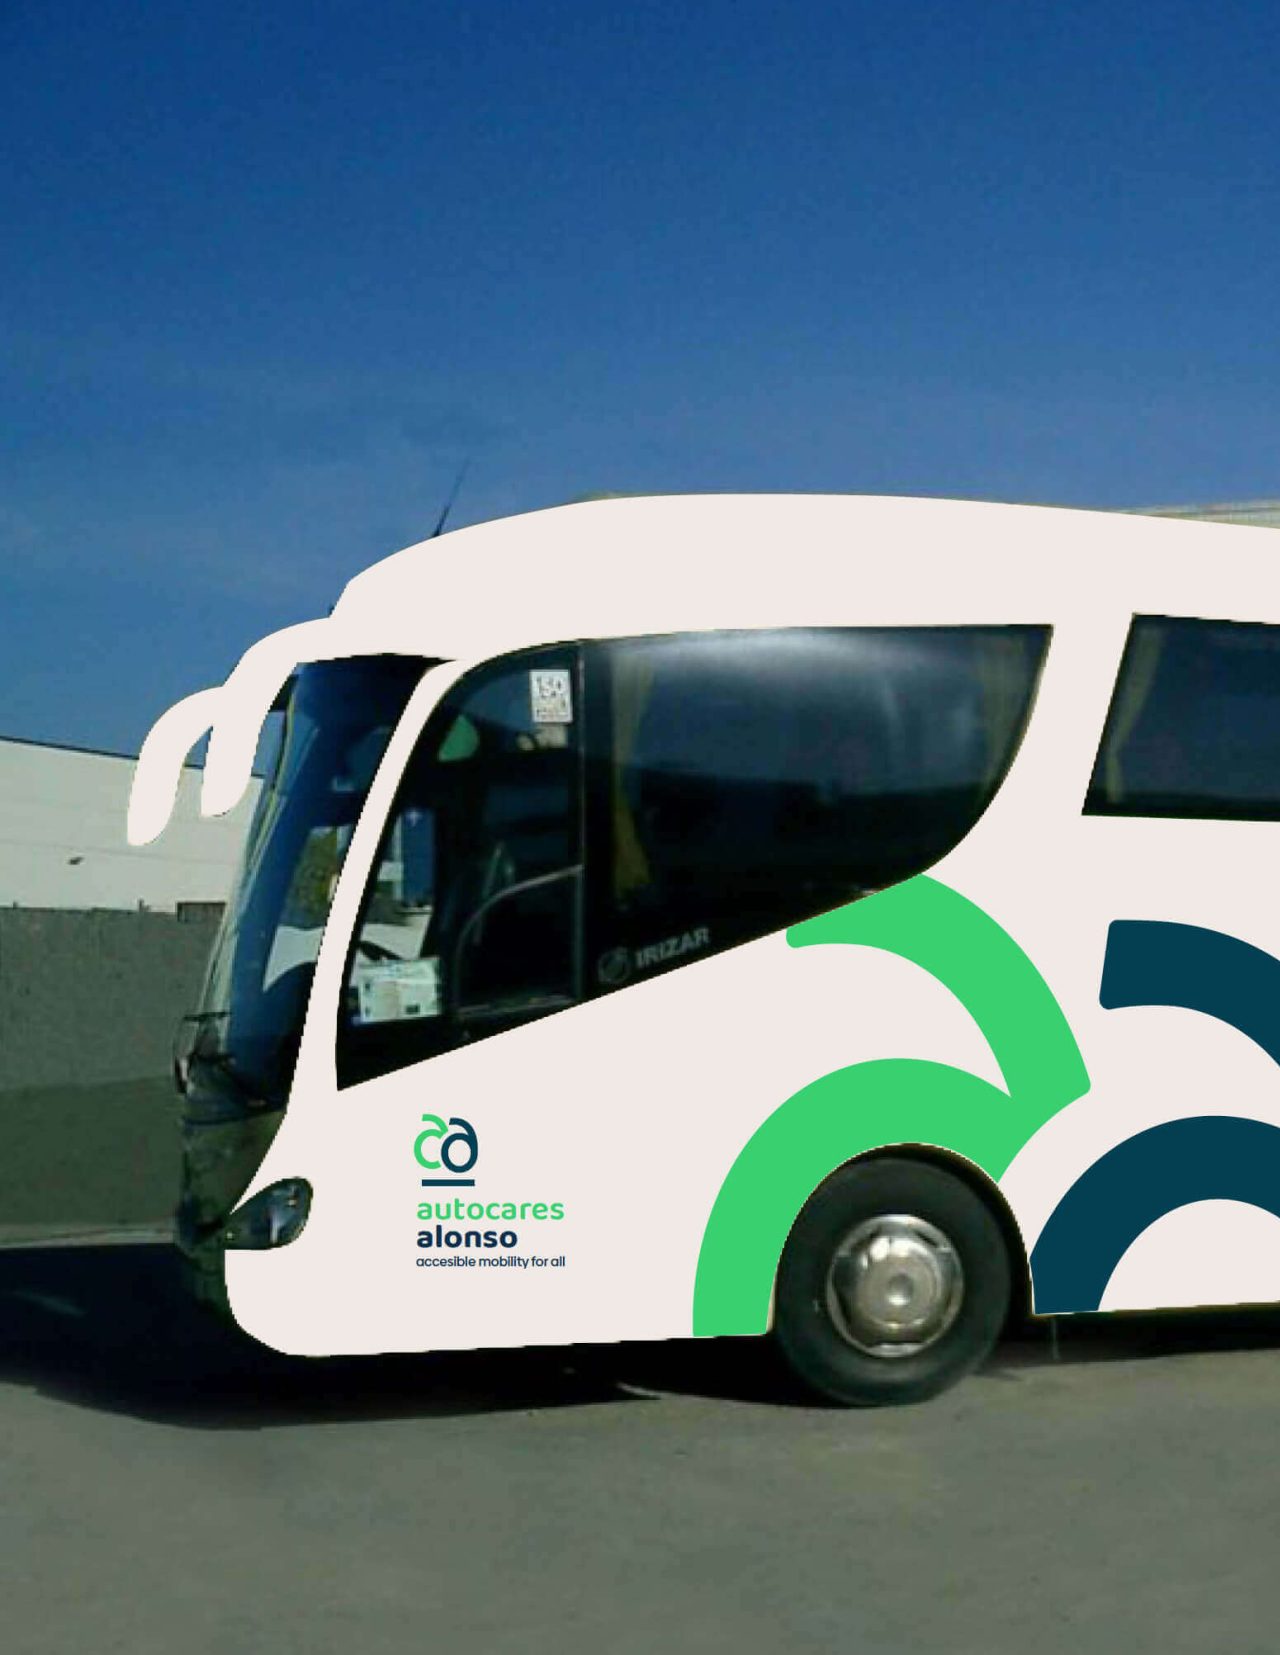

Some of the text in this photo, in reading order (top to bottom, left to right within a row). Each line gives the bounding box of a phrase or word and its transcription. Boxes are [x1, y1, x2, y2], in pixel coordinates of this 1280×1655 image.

[636, 928, 710, 969] IRIZAR
[416, 1198, 565, 1220] autocares
[416, 1224, 518, 1249] alonso
[415, 1255, 566, 1270] accesible mobility for all
